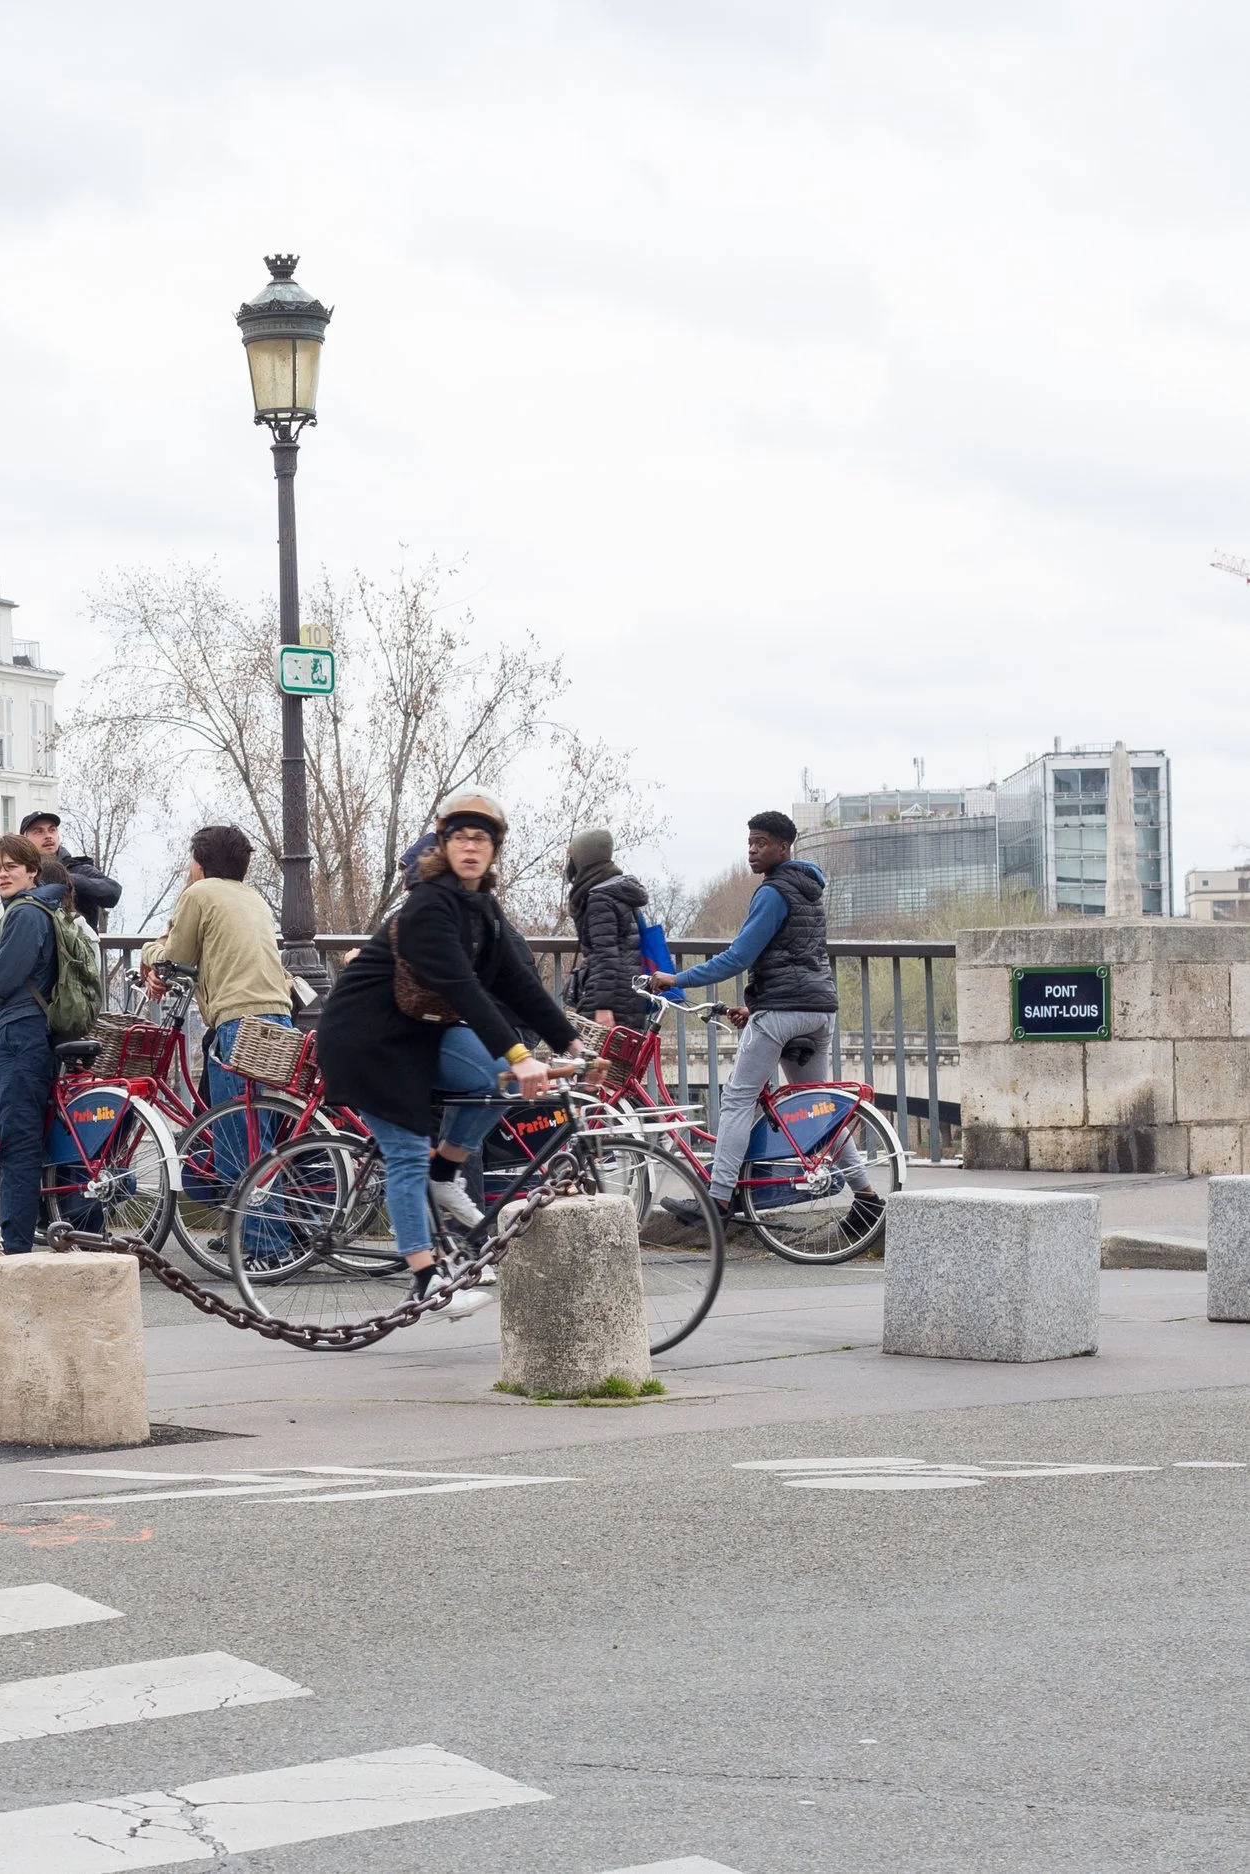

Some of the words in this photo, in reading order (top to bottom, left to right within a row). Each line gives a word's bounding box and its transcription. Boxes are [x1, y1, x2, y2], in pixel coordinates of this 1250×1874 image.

[306, 626, 321, 644] 10
[1045, 985, 1078, 998] PONT
[1024, 1005, 1099, 1018] SAINT-LOUIS
[554, 1108, 568, 1124] Bi
